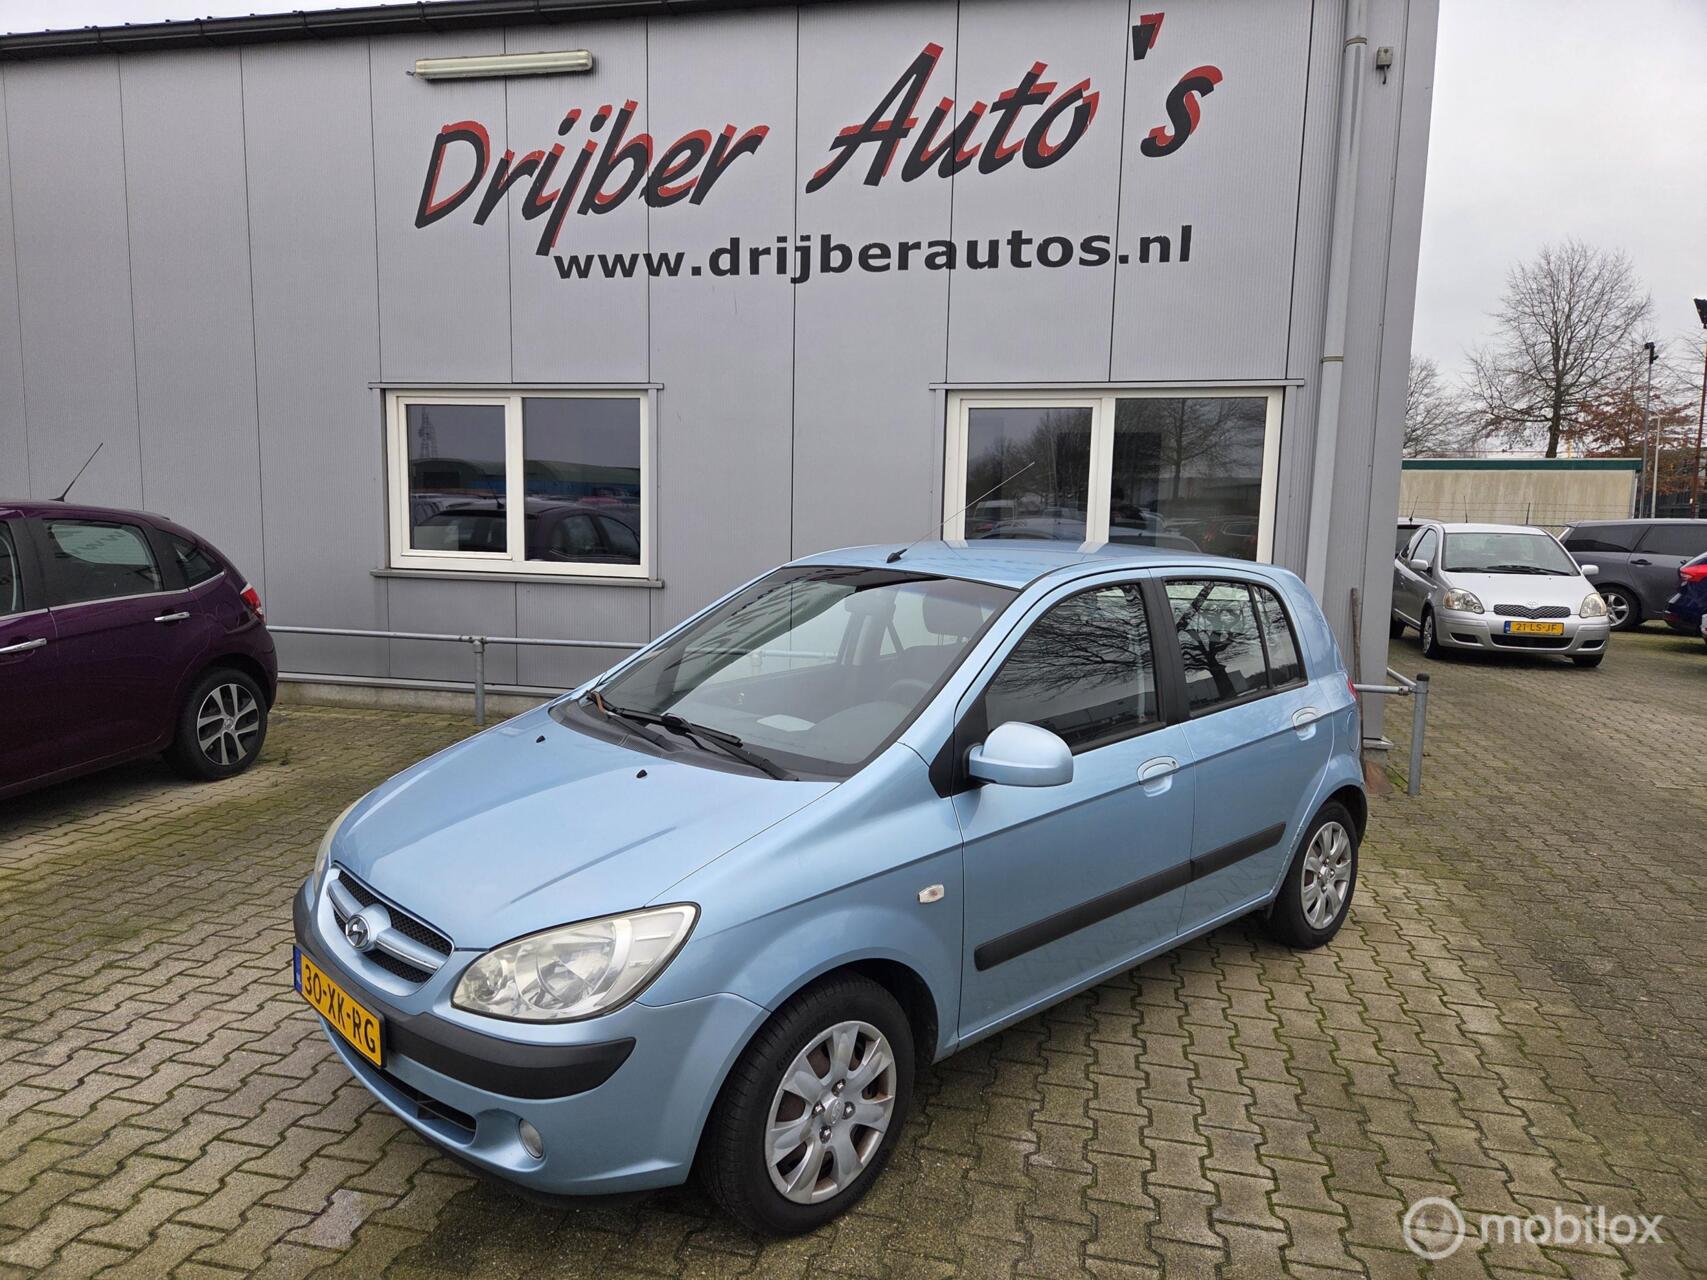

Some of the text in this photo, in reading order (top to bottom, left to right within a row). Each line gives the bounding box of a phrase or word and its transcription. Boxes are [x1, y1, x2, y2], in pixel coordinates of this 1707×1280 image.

[415, 12, 1223, 256] Drijber Auto's
[554, 225, 1193, 284] www.drijberautos.nl
[304, 963, 376, 1054] 30-XK-RG
